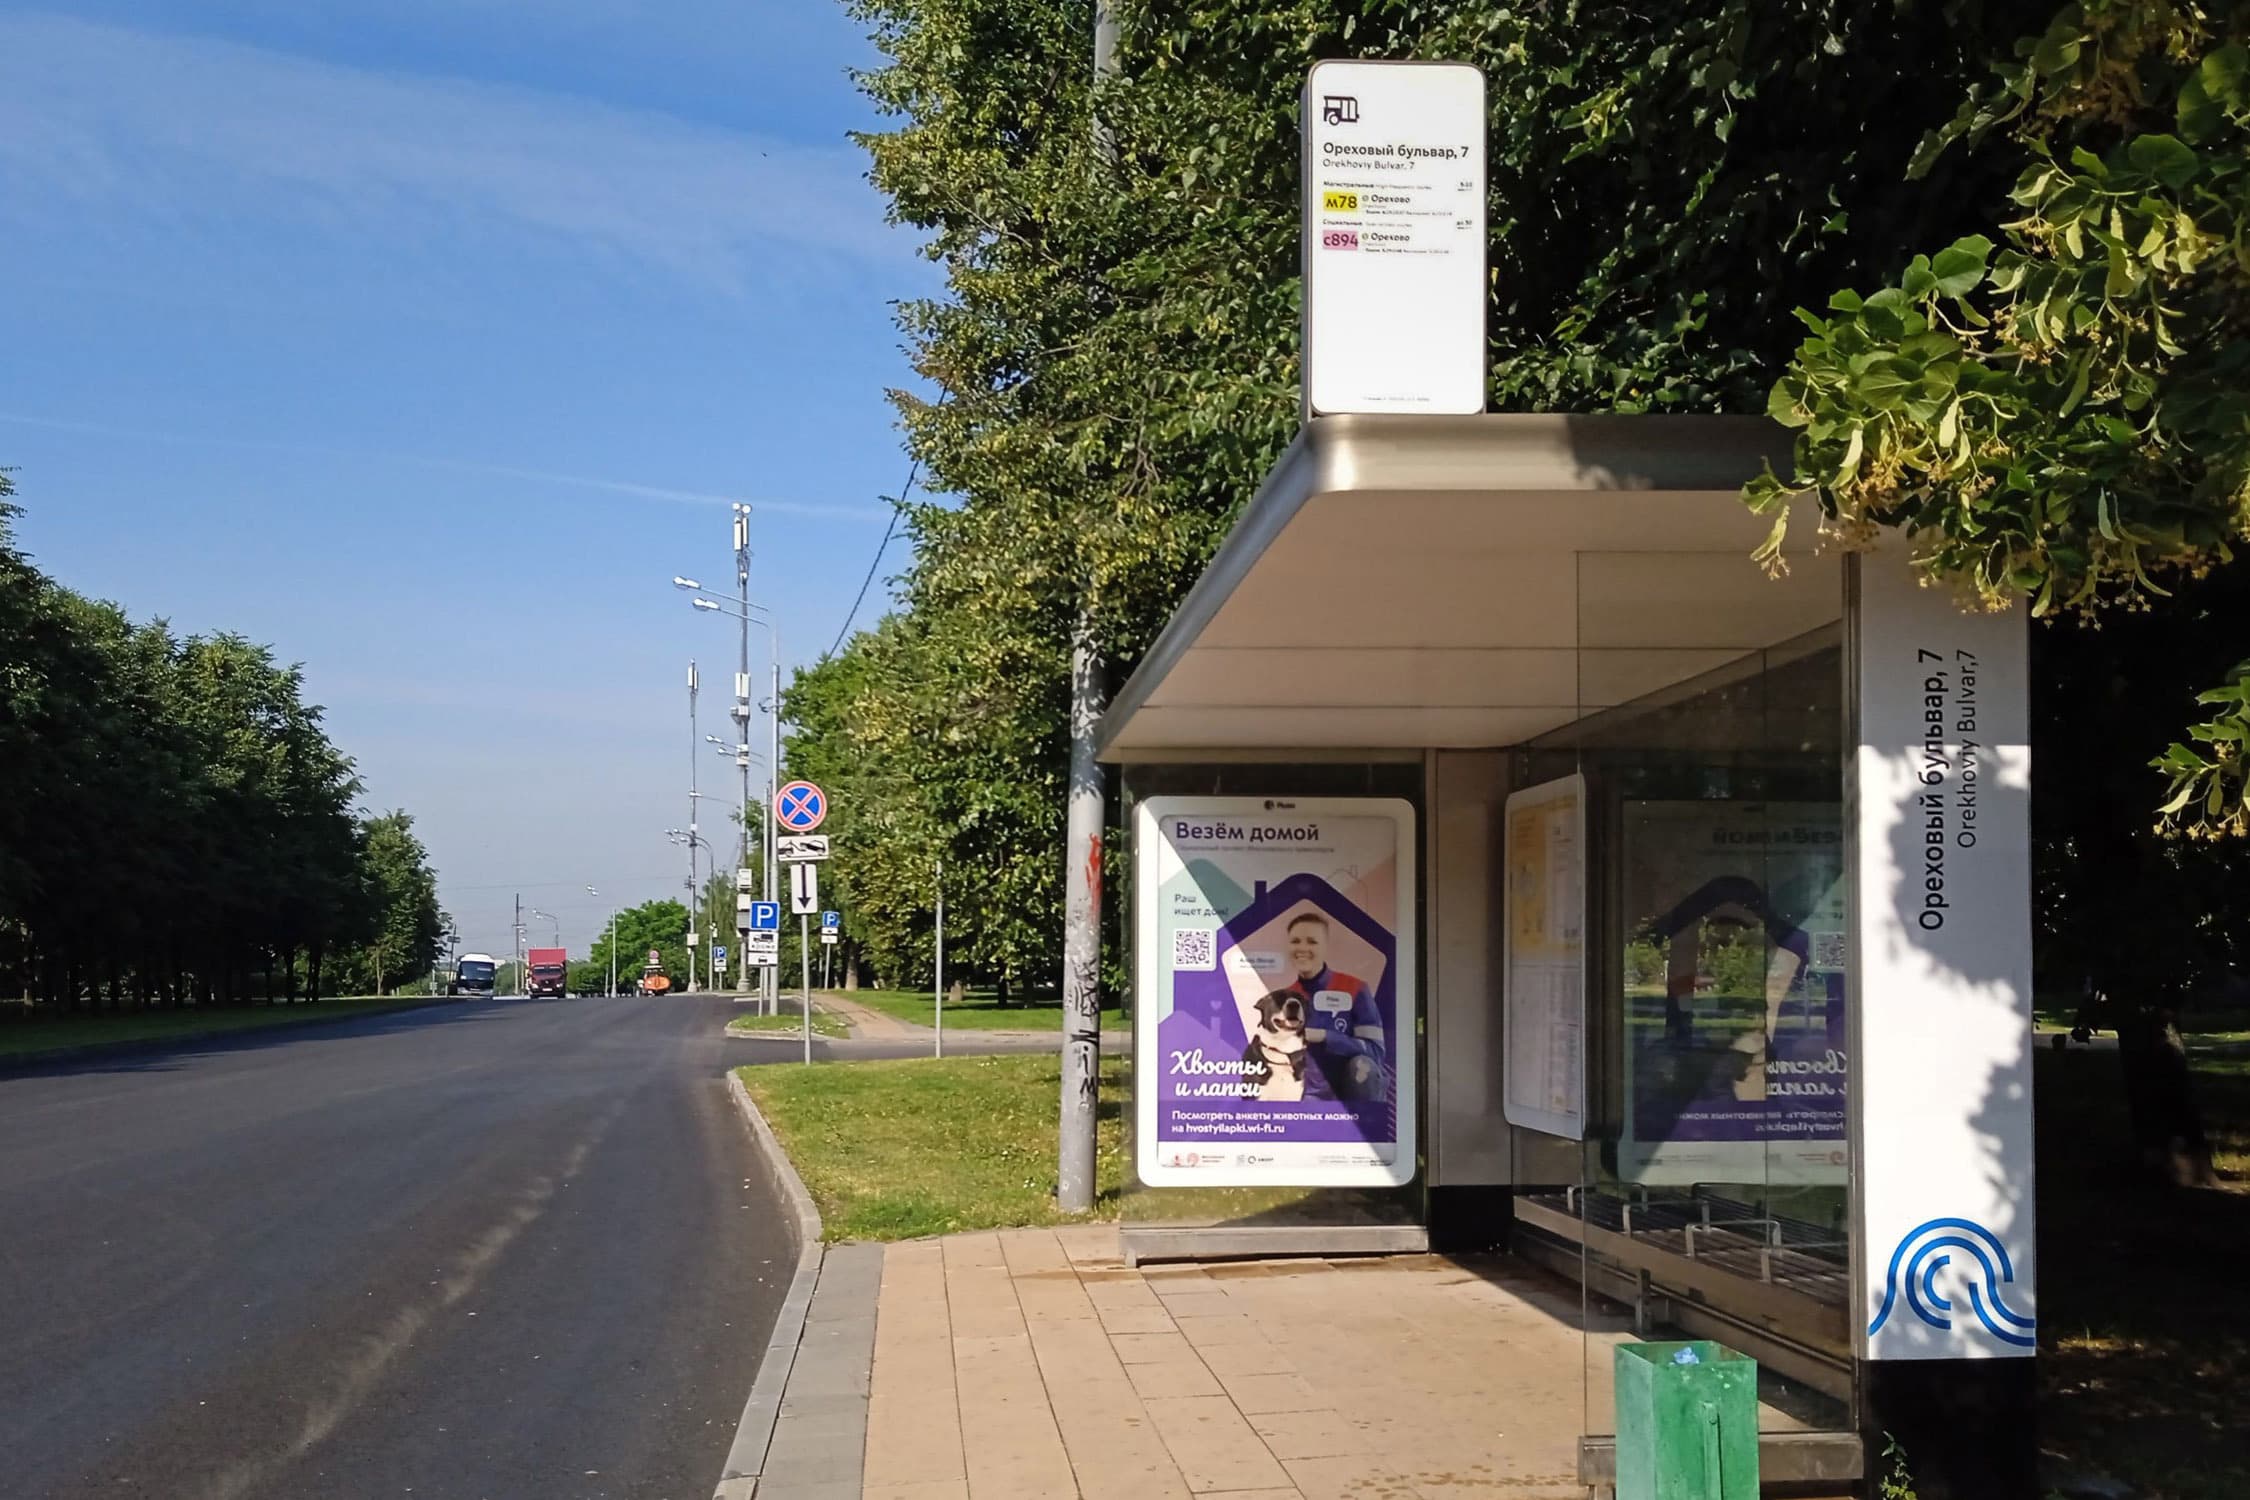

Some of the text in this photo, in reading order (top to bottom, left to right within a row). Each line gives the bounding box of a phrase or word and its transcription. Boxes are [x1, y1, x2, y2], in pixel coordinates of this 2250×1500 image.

[1323, 142, 1469, 159] Ореховый бульвар, 7
[1323, 158, 1371, 170] Orekhoviy
[1408, 161, 1415, 170] 7
[1371, 194, 1411, 204] Орехово
[1323, 234, 1359, 248] с894
[1370, 232, 1410, 242] Орехово
[1918, 648, 1952, 930] Ореховый бульвар, 7
[1956, 739, 1980, 849] Orekhoviy
[1176, 822, 1319, 842] Везём домой
[1174, 893, 1197, 903] Раш
[757, 905, 773, 926] P
[1174, 907, 1201, 917] ищет
[1169, 1049, 1268, 1076] Хвосты
[1174, 1081, 1262, 1098] и лапки
[1171, 1111, 1360, 1121] Посмотреть анкеты животных можно
[1171, 1125, 1184, 1133] на
